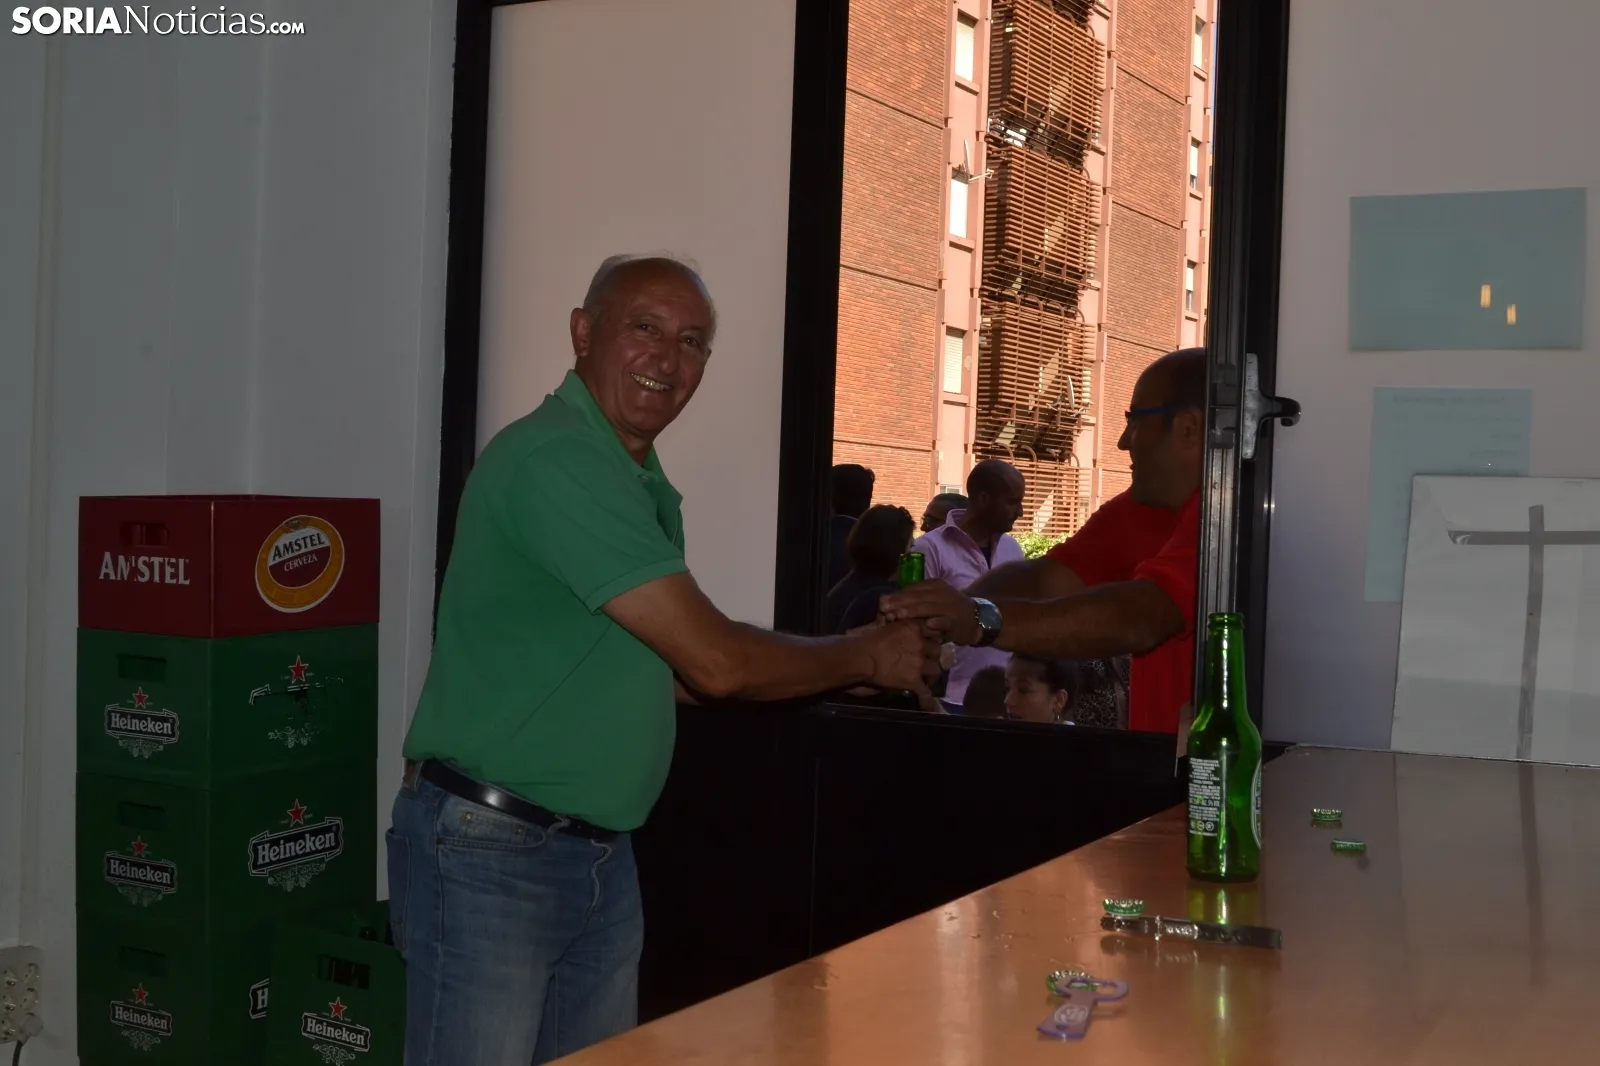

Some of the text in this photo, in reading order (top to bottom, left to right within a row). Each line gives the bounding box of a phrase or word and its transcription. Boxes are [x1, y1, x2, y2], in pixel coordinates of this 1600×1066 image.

[272, 532, 325, 561] AMSTEL
[284, 553, 318, 572] CERVEZA
[110, 713, 172, 735] Heineken
[256, 832, 336, 866] Heineken
[109, 860, 171, 884] Heineken
[114, 1006, 168, 1031] Heineken
[306, 1018, 365, 1045] Heineken
